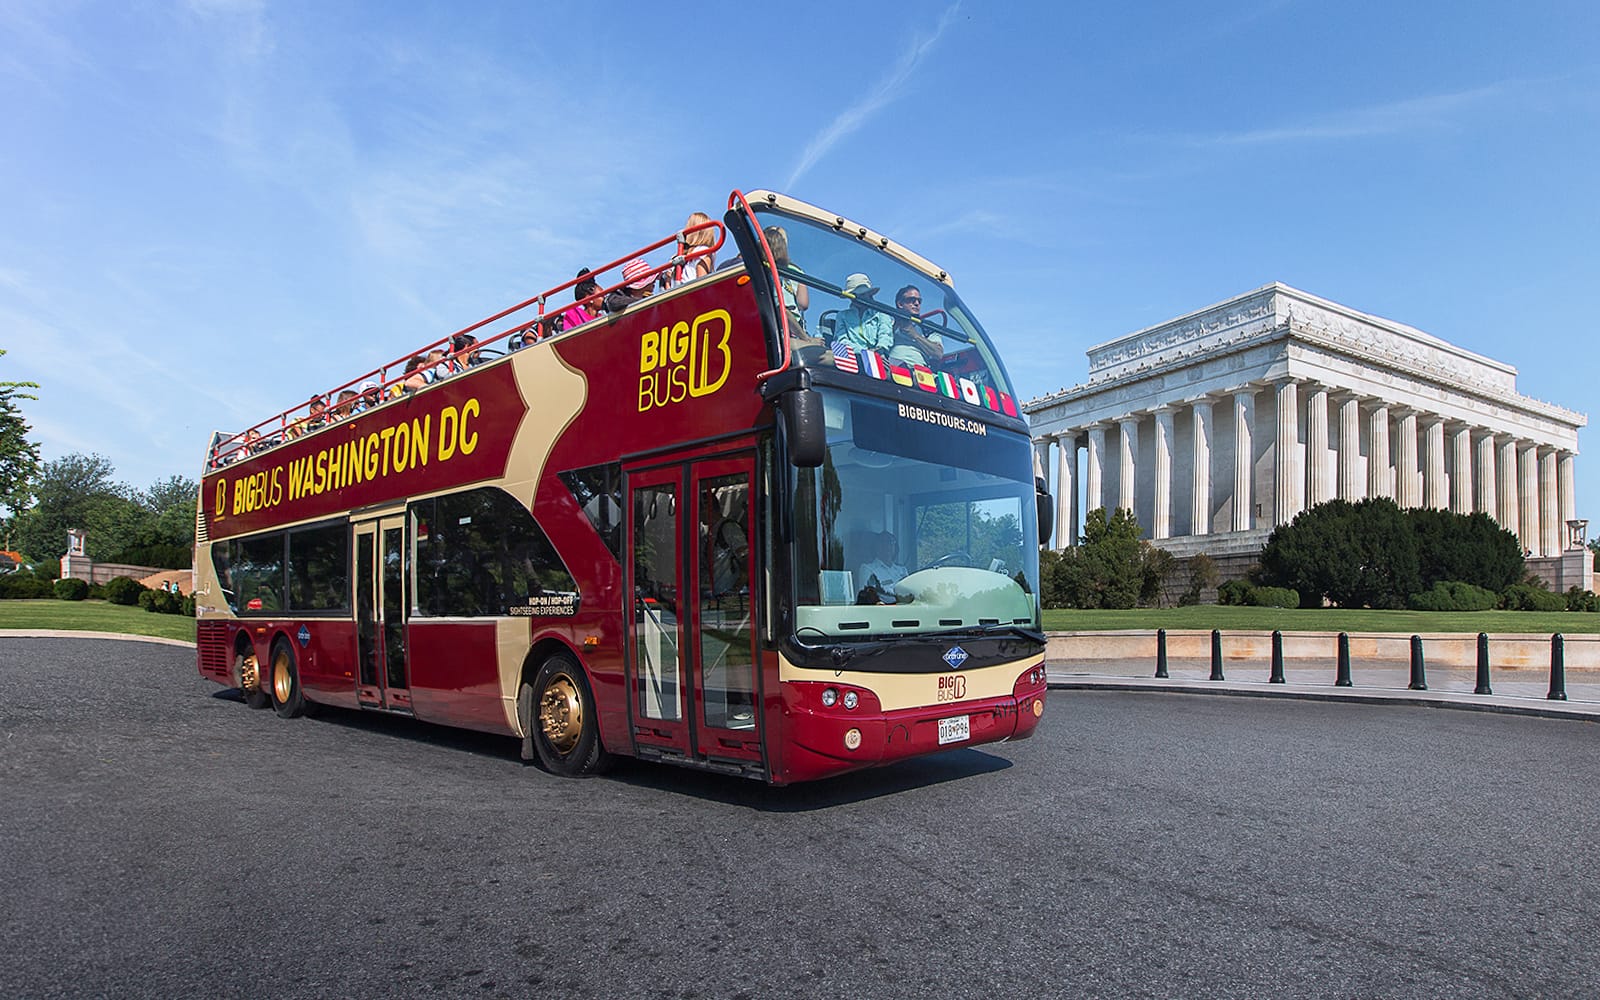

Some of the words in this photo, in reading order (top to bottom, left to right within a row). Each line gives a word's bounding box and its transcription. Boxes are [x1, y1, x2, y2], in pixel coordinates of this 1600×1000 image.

[640, 321, 689, 373] BIG
[638, 365, 687, 412] BUS
[898, 403, 987, 437] BIGBUSTOURS.COM
[288, 413, 431, 501] WASHINGTON
[438, 398, 480, 461] DC
[528, 596, 547, 606] HOP-ON
[551, 595, 573, 605] HOP-OFF
[540, 605, 574, 615] EXPERIENCES
[938, 676, 954, 689] BIG
[937, 689, 953, 702] BUS
